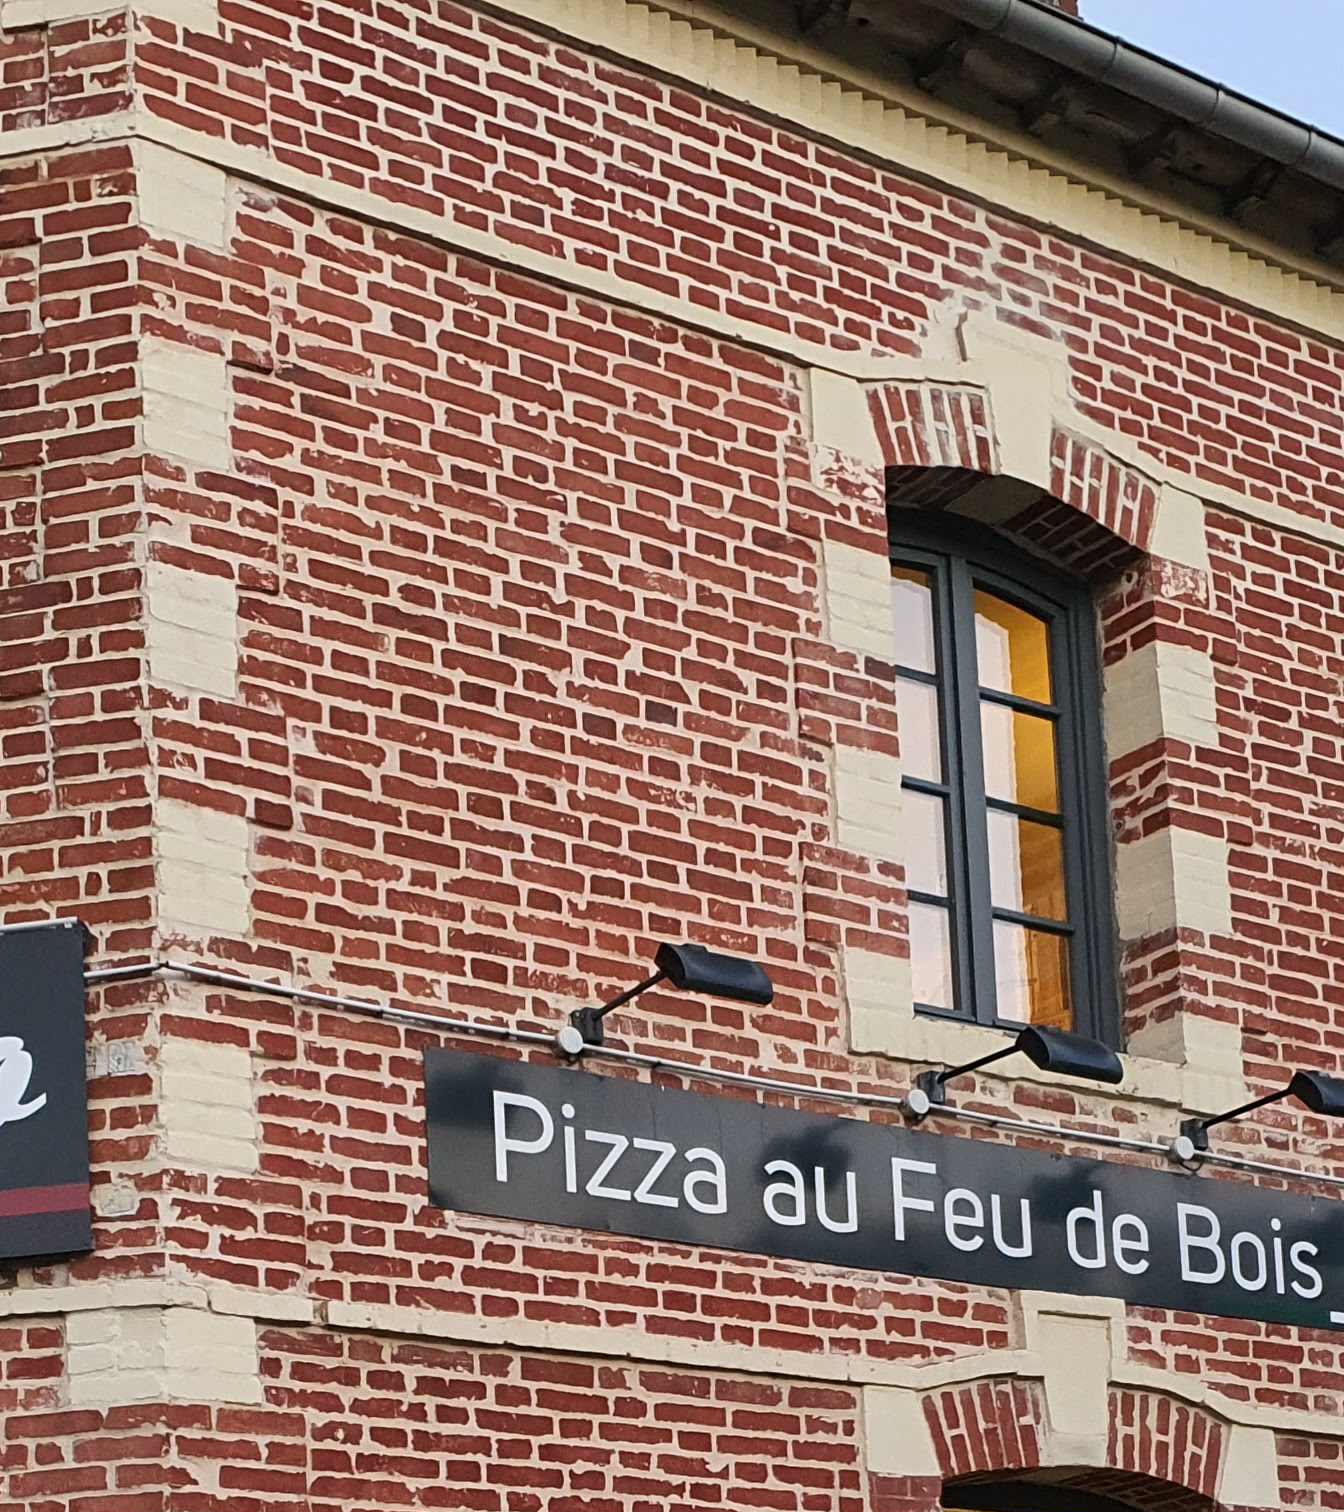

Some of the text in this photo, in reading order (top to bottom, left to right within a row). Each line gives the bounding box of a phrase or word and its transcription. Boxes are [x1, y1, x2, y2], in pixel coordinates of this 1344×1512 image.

[493, 1090, 728, 1214] Pizza
[763, 1158, 859, 1233] au
[891, 1157, 1033, 1258] Feu
[1066, 1190, 1150, 1276] de
[1177, 1202, 1324, 1299] Bois
